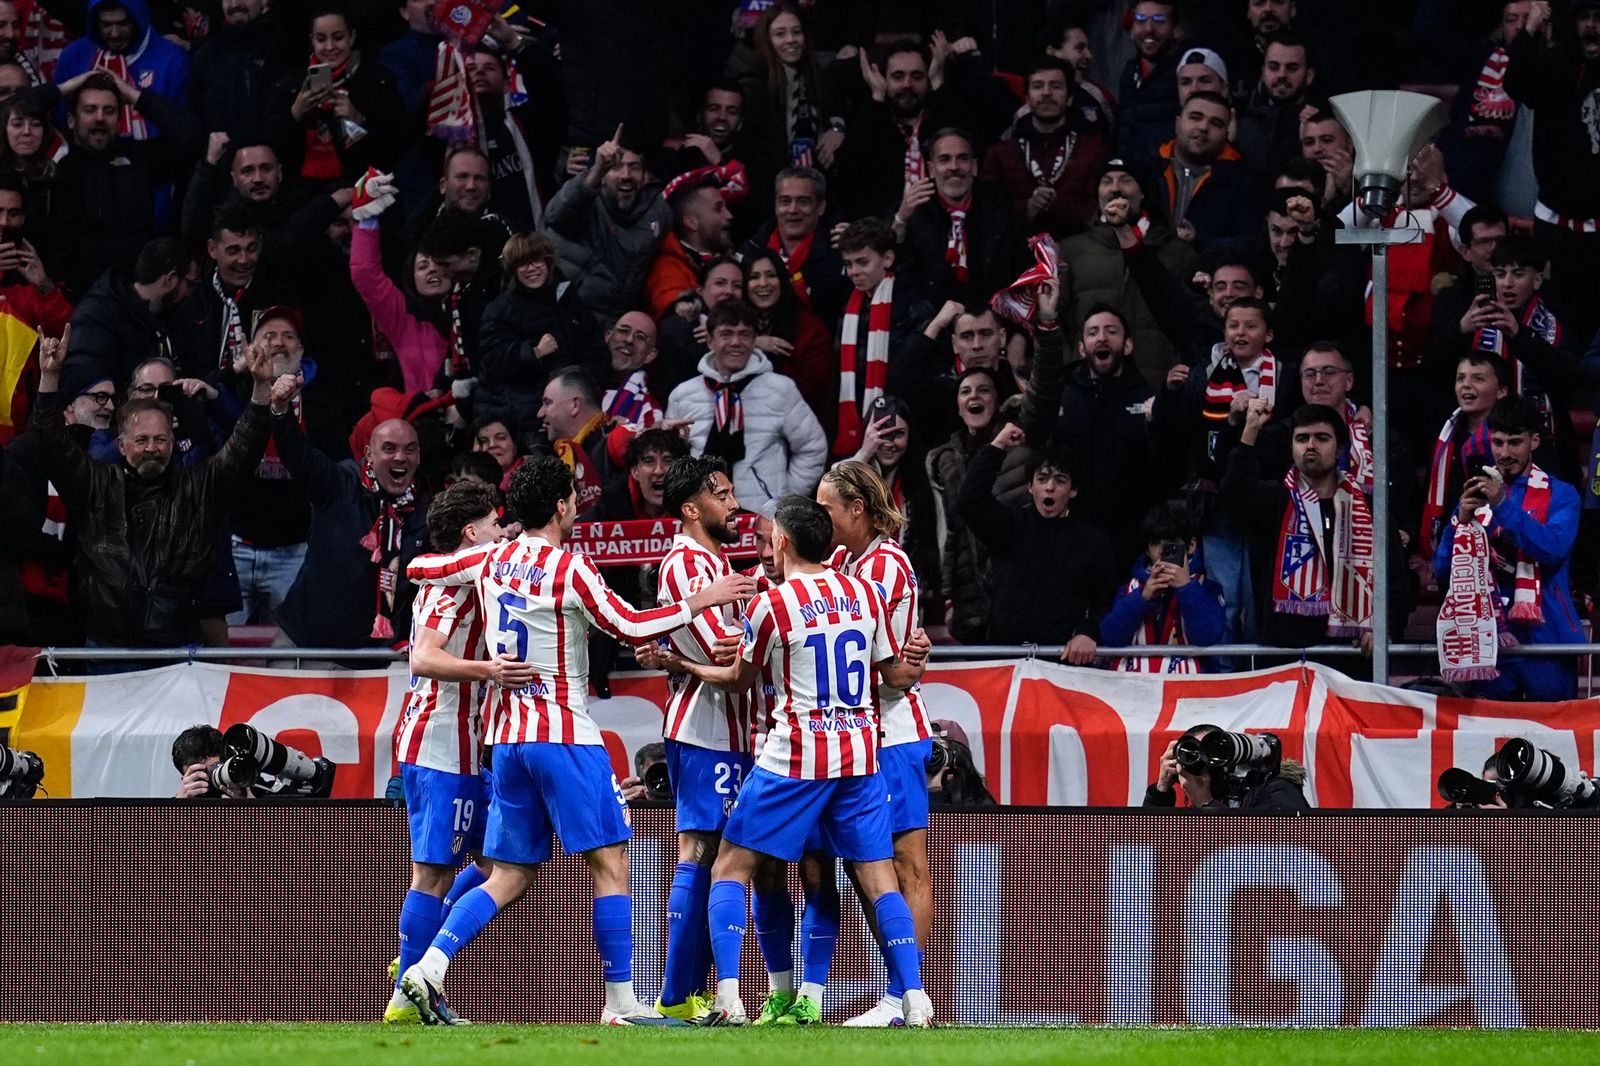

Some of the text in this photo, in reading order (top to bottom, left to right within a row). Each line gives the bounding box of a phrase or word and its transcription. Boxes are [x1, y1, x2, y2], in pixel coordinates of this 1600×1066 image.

[571, 521, 624, 539] EÑA
[494, 561, 547, 586] JOHNNY
[799, 597, 861, 622] MOLINA
[497, 592, 529, 663] 5
[803, 629, 867, 708] 16
[809, 716, 873, 732] RWANDA
[714, 762, 742, 795] 23
[452, 798, 475, 832] 19
[633, 838, 1527, 1027] LLIGA
[887, 937, 915, 947] ATLETI
